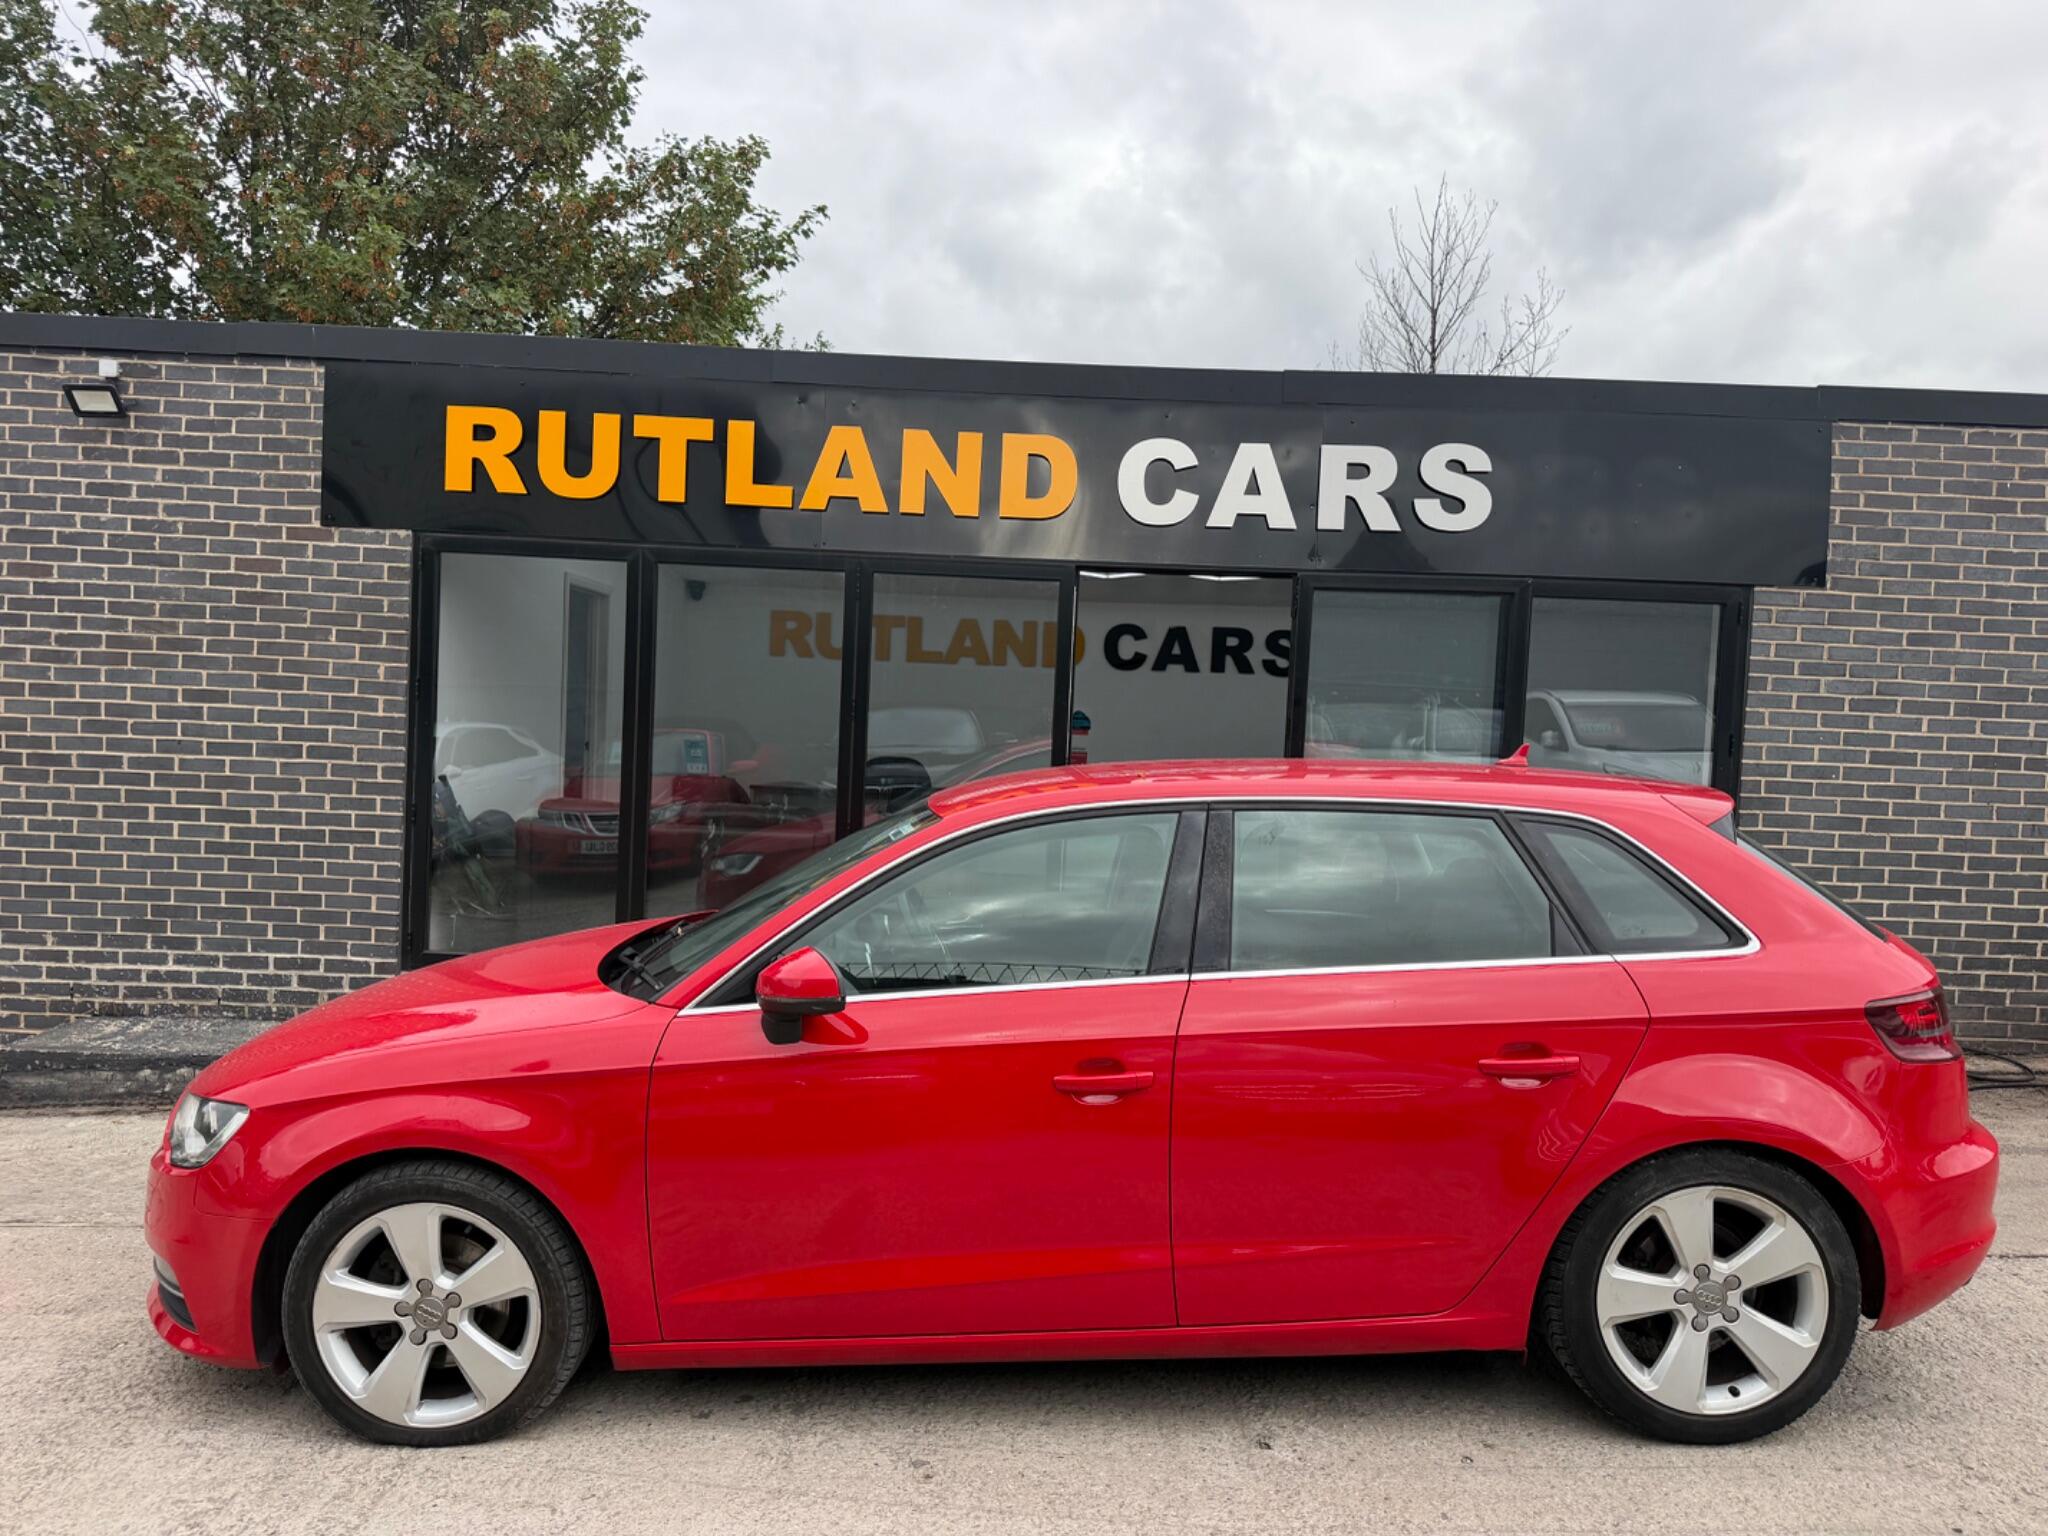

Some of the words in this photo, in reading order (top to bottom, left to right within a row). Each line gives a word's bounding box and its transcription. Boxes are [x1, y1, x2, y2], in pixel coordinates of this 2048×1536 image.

[444, 405, 1078, 520] RUTLAND
[1117, 437, 1494, 532] CARS
[1103, 623, 1291, 678] CARS
